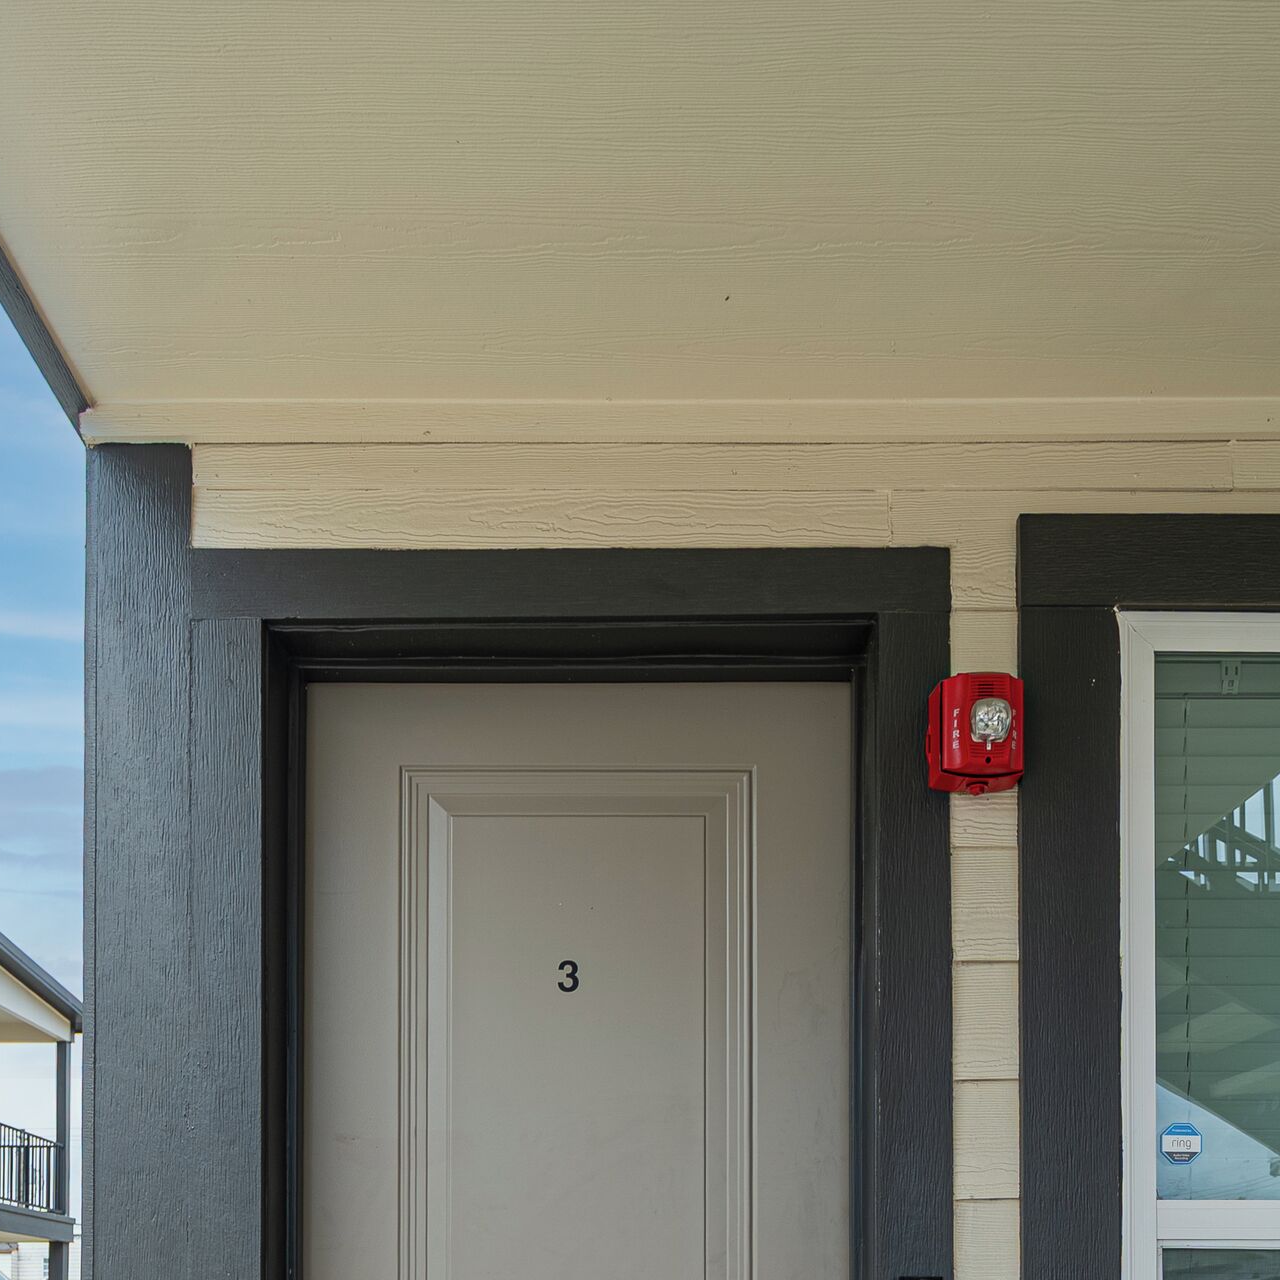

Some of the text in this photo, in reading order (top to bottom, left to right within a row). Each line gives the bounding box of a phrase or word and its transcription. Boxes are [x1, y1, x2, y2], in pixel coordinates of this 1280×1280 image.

[952, 708, 960, 750] FIRE
[557, 960, 580, 993] 3
[1171, 1137, 1192, 1150] ring
